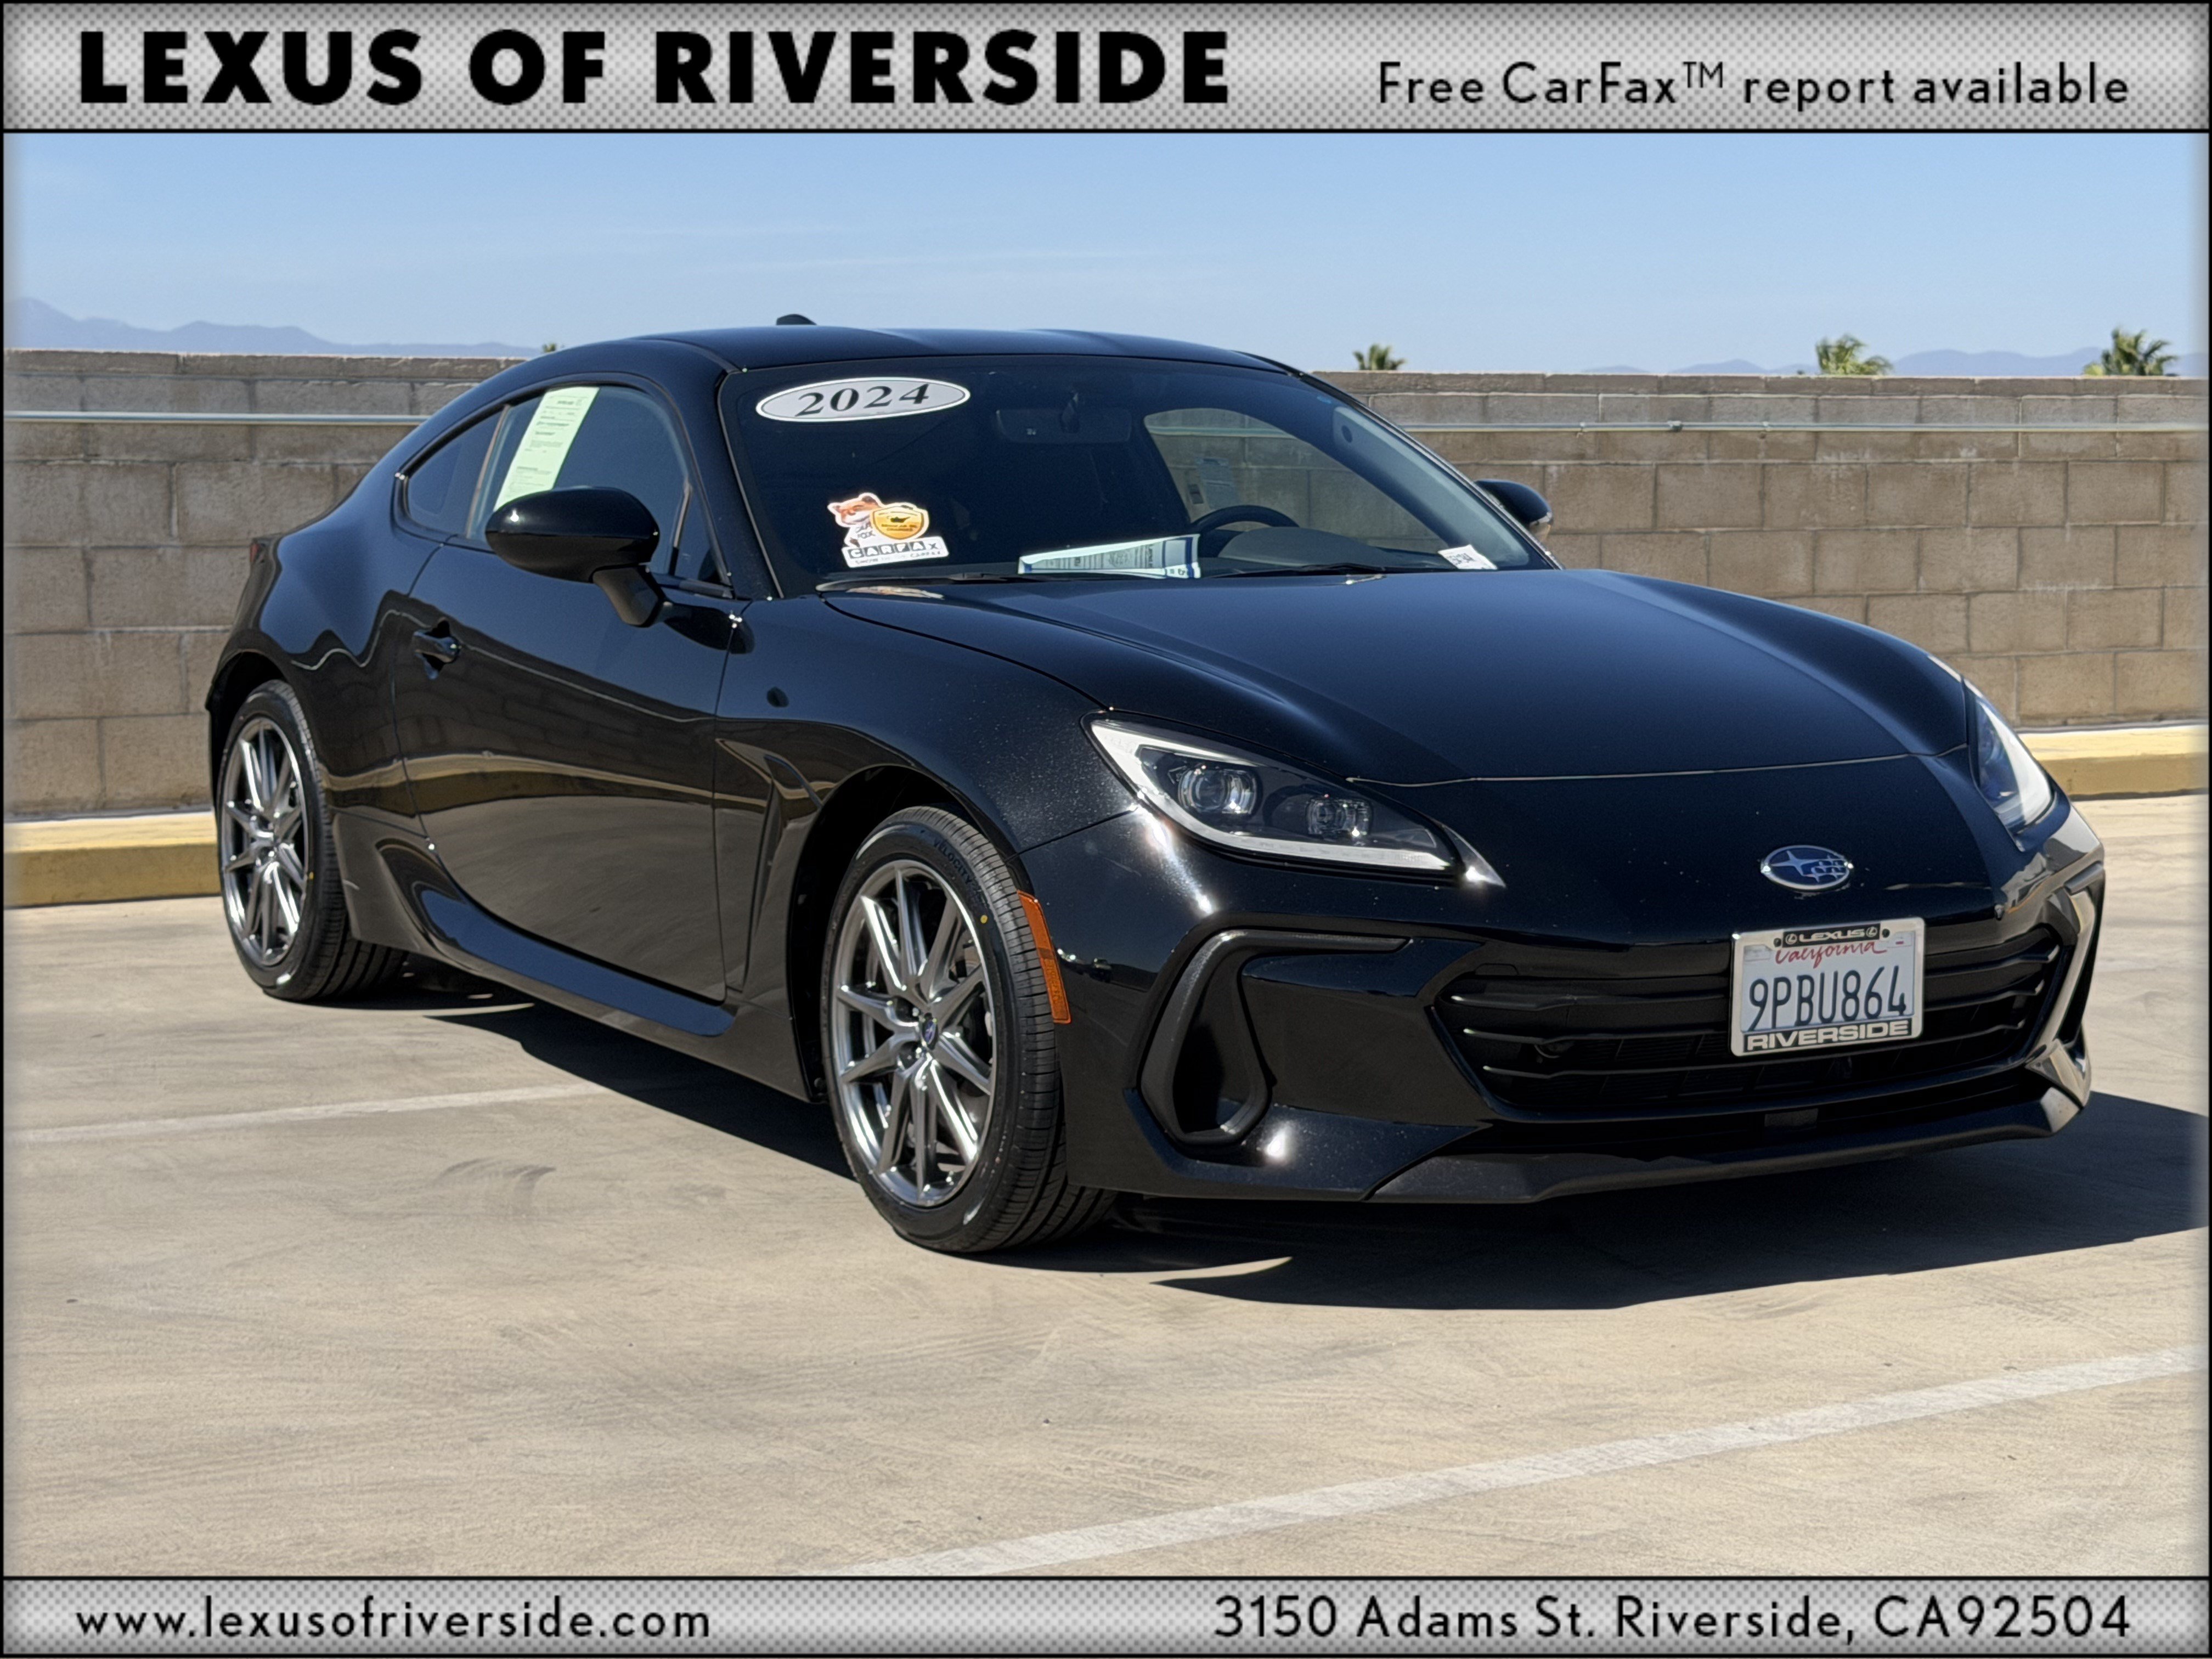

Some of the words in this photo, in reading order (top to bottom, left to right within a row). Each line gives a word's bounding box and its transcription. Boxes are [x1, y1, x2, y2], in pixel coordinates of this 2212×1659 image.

[795, 383, 929, 417] 2024
[848, 540, 939, 558] CARFAX
[1799, 928, 1865, 943] LEXUS
[1775, 940, 1887, 969] California
[1748, 965, 1906, 1031] 9PBU864
[1747, 1019, 1909, 1051] RIVERSIDE
